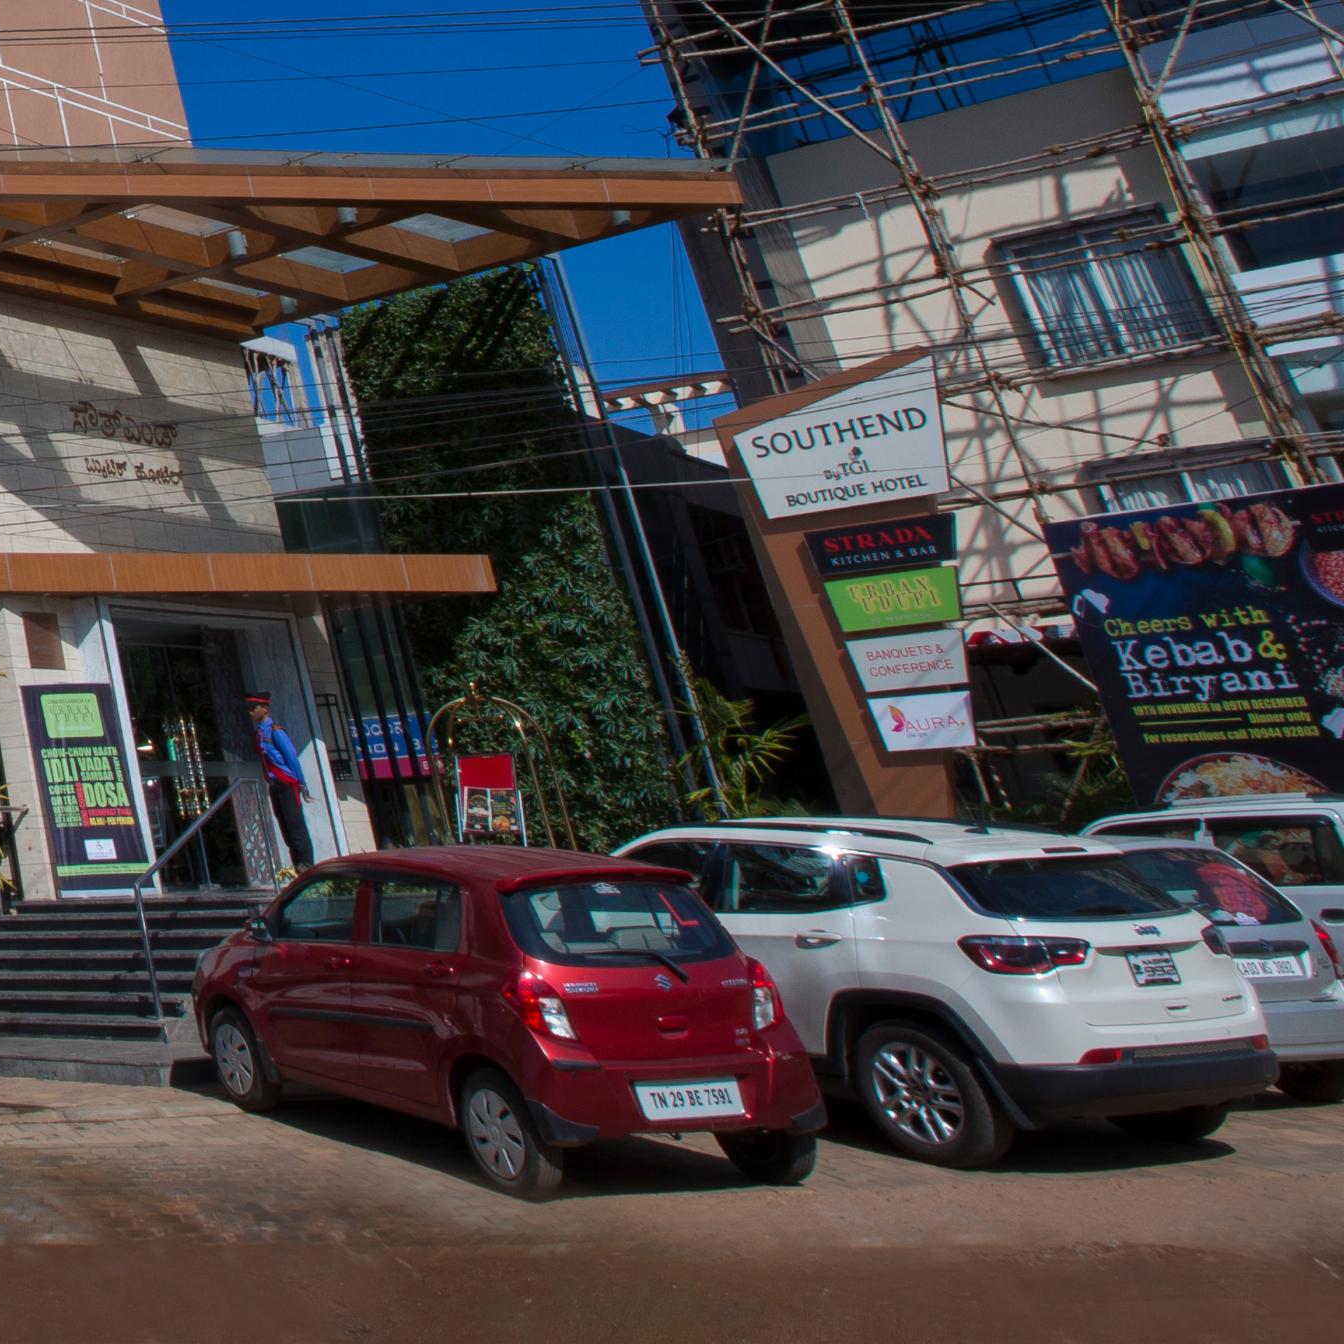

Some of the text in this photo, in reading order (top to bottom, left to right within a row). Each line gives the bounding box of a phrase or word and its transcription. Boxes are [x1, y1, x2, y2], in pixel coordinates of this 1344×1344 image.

[751, 407, 928, 459] SOUTHEND
[823, 459, 871, 481] By TGI
[785, 474, 928, 508] BOUTIQUE HOTEL
[823, 526, 933, 553] STRADA
[830, 545, 938, 567] KITCHEN & BAR
[848, 577, 929, 601] URBAN
[860, 589, 939, 612] UDUPI
[1103, 605, 1271, 637] Cheers with
[865, 643, 944, 662] BANQUETS &
[1110, 629, 1289, 672] Kebab &
[869, 658, 954, 677] CONFERENCE
[1119, 662, 1300, 702] Biryani
[1157, 702, 1210, 715] NOVEMBER
[1251, 696, 1307, 710] DECEMBER
[905, 714, 960, 733] AURA
[1248, 710, 1312, 724] Dinner only
[1161, 729, 1227, 743] reservations
[1227, 728, 1248, 741] call
[40, 745, 92, 759] CHOW-CHOW
[43, 757, 79, 783] IDLI
[77, 756, 112, 771] VADA
[81, 781, 130, 808] DOSA
[649, 1088, 733, 1109] TN 29 BE 7591
